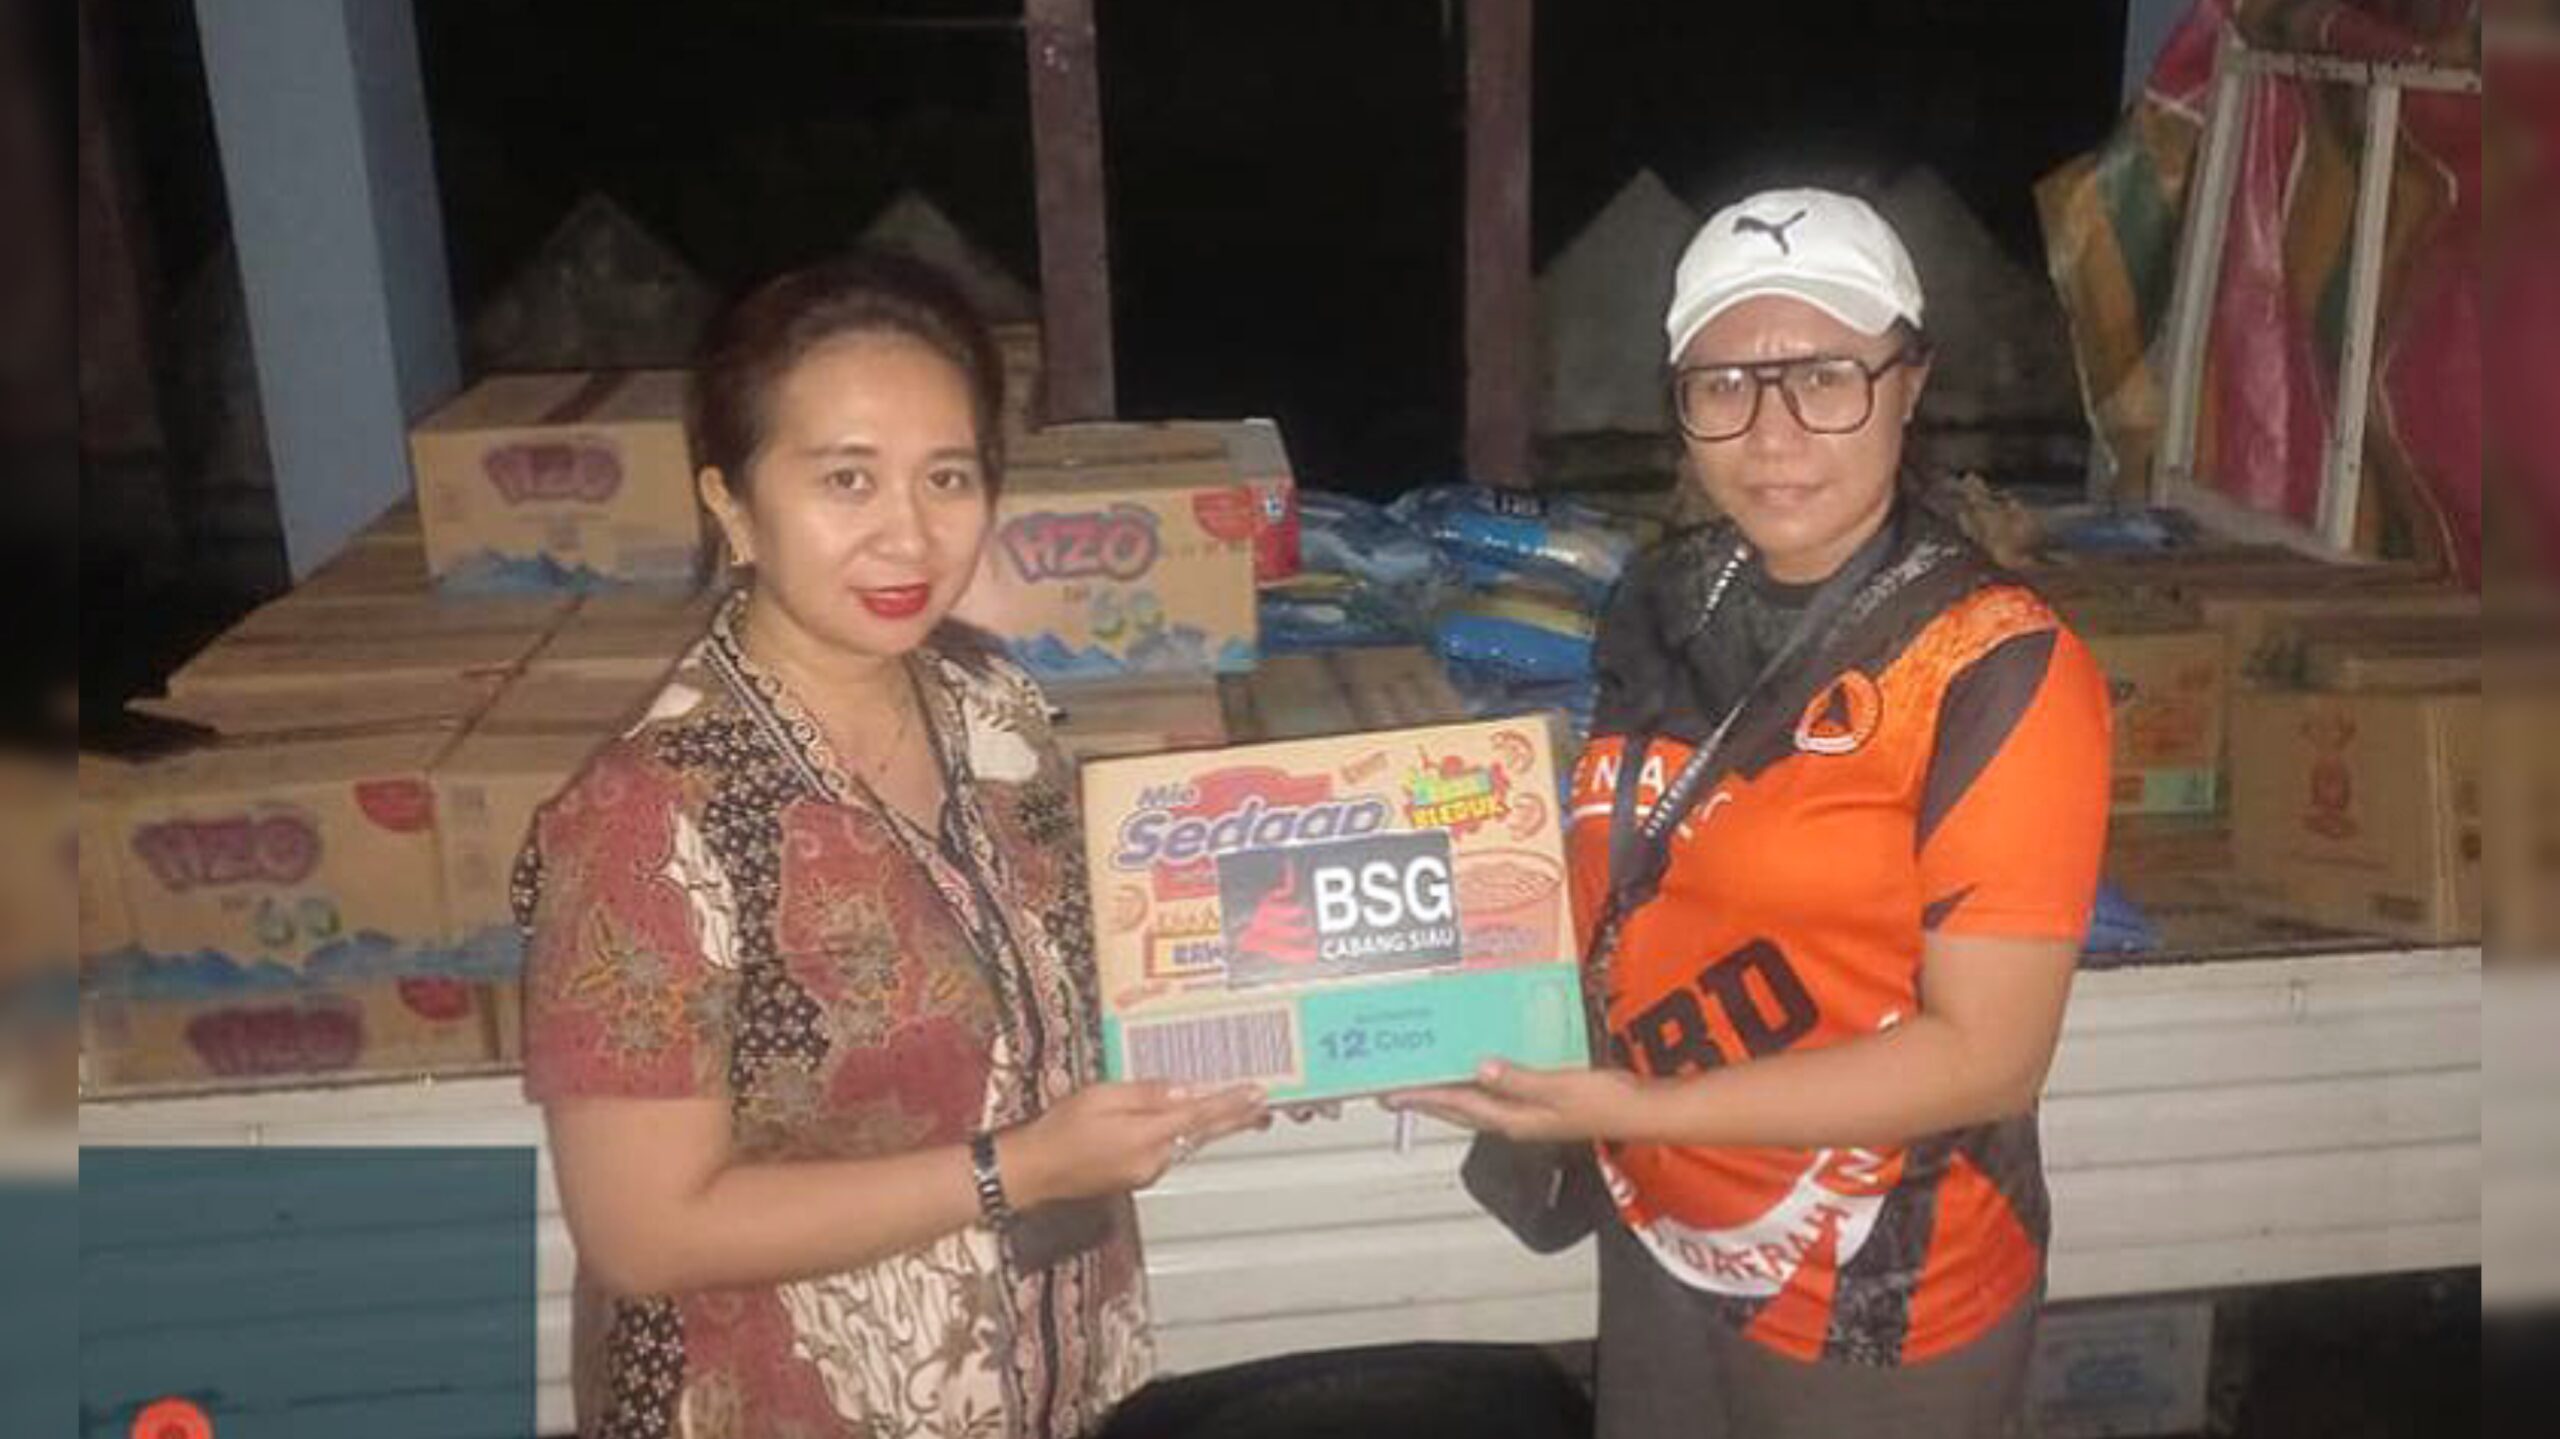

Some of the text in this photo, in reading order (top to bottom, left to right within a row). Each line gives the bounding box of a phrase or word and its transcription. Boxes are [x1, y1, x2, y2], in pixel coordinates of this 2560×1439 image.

[1313, 855, 1454, 935] BSG
[1321, 931, 1406, 962] CABANG
[1408, 925, 1456, 951] SIAU
[1318, 1028, 1371, 1060] 12
